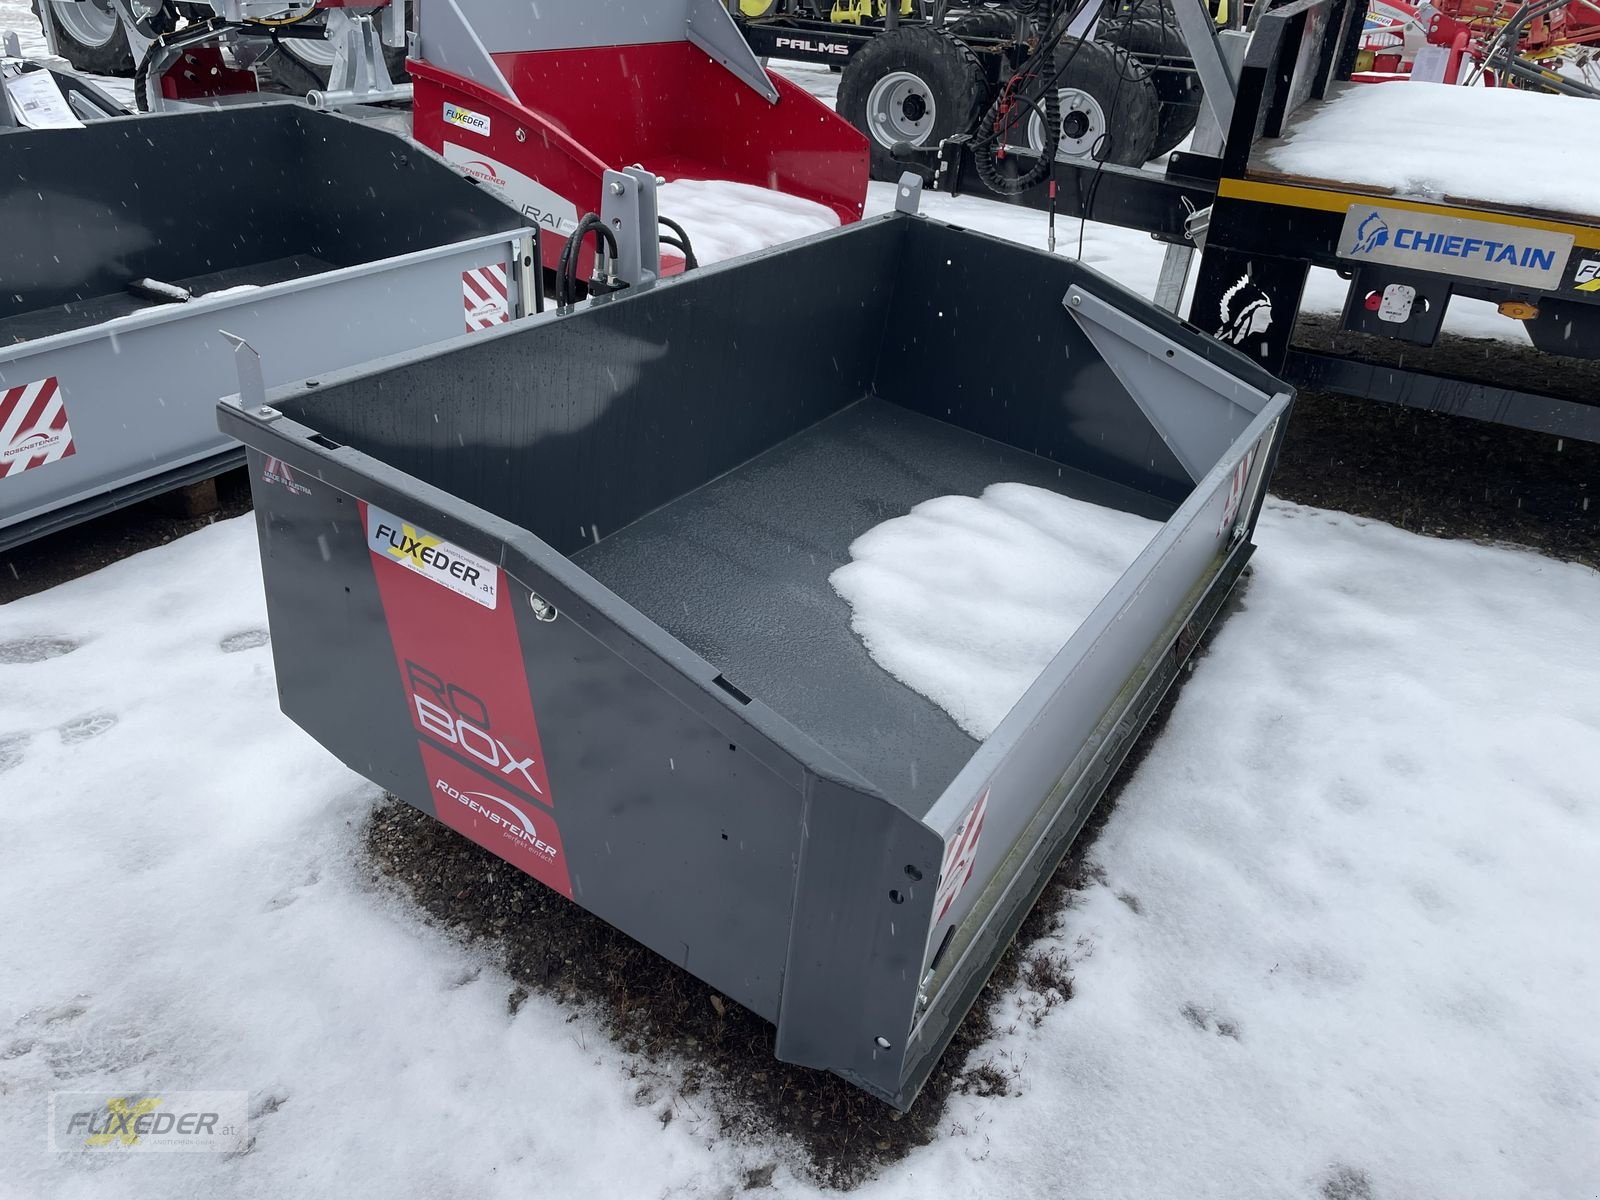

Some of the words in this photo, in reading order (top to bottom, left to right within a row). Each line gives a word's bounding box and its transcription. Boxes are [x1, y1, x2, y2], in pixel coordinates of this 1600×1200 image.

[776, 37, 849, 55] PALMS
[1393, 228, 1556, 271] CHIEFTAIN
[4, 435, 59, 457] ROSENSTEINER
[405, 658, 490, 731] RO
[413, 693, 543, 795] BOX
[436, 778, 557, 857] ROSENSTEINER
[503, 832, 529, 849] perfekt
[528, 844, 553, 864] einfach
